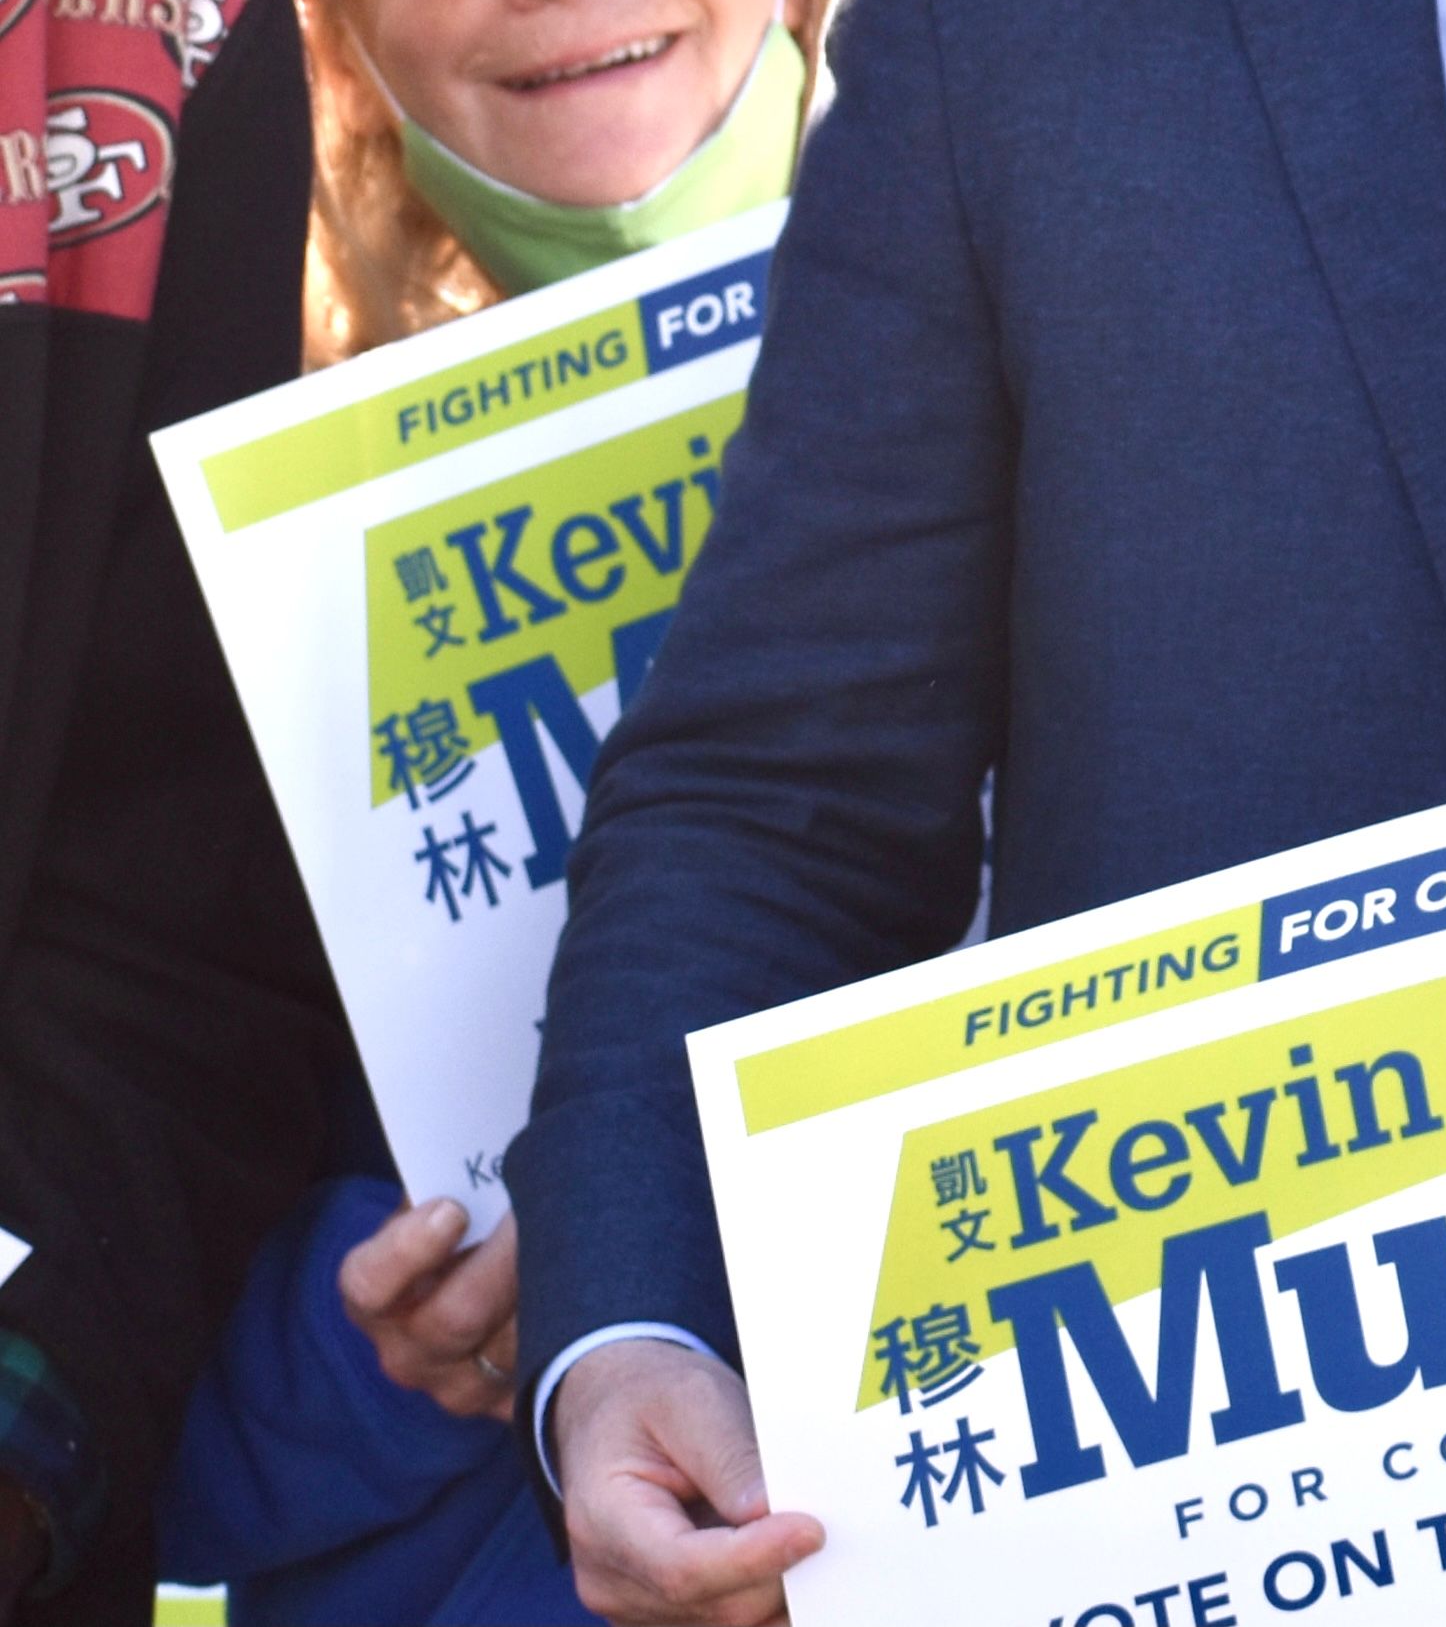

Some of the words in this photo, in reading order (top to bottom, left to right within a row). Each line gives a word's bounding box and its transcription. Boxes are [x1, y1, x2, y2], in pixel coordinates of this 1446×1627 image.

[396, 329, 630, 444] FIGHTING
[655, 280, 757, 352] FOR
[372, 697, 513, 924] 穆林
[962, 931, 1244, 1048] FIGHTING
[1276, 887, 1399, 957] FOR
[929, 1148, 997, 1264] 凱文
[991, 1042, 1446, 1252] Kevin
[871, 1302, 1007, 1529] 穆林
[1173, 1465, 1329, 1539] FOR
[1261, 1527, 1397, 1612] ON
